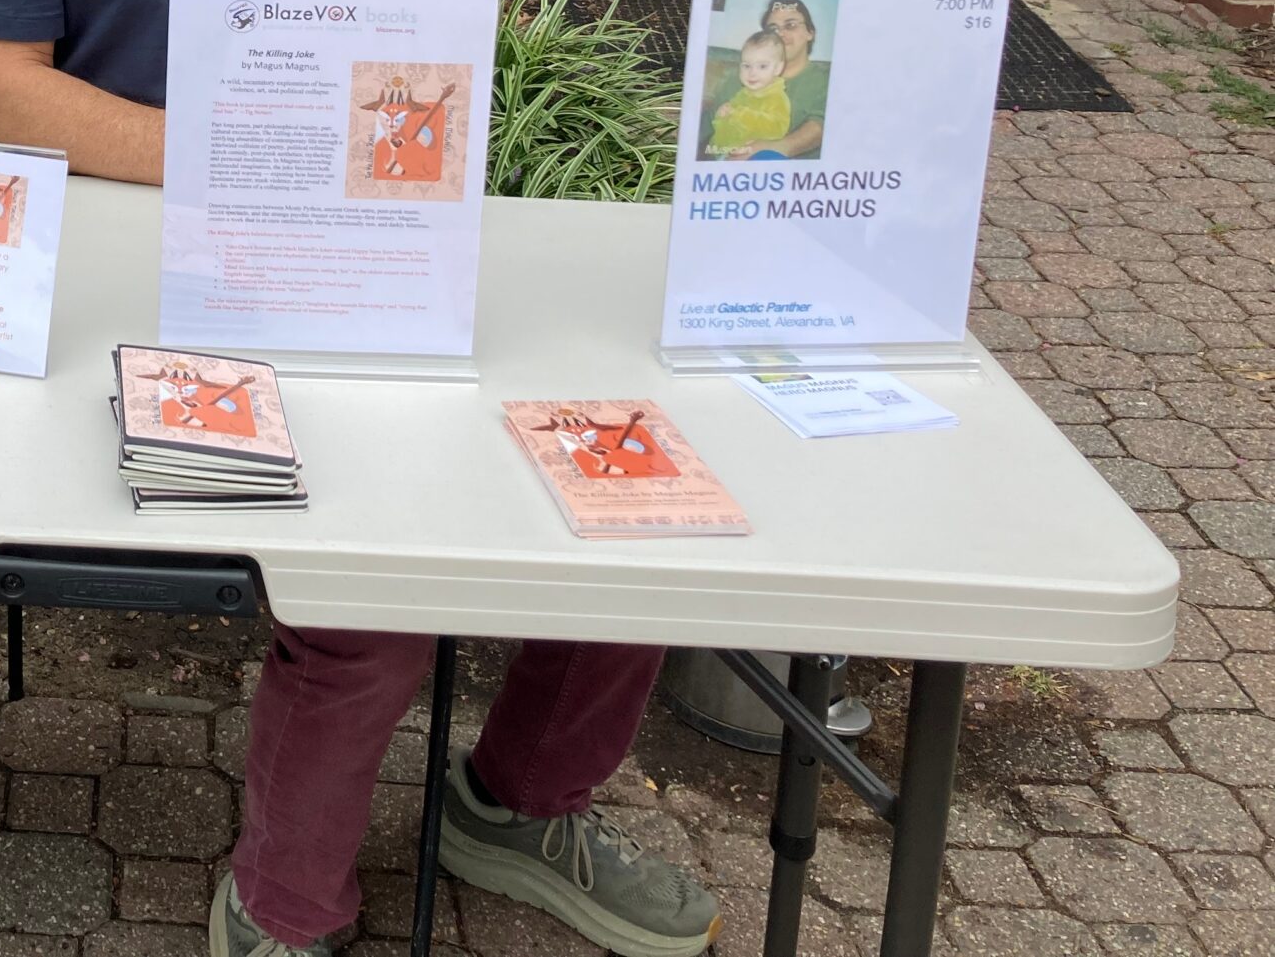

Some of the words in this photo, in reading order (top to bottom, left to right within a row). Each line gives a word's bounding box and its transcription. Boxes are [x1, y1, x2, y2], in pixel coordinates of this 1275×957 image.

[771, 1, 799, 13] Poet
[366, 6, 418, 23] books
[965, 16, 992, 29] $16
[248, 49, 265, 58] The
[266, 49, 296, 60] Killing
[298, 50, 315, 59] Joke
[241, 61, 252, 70] by
[254, 61, 283, 71] Magus
[285, 62, 320, 72] Magnus
[691, 172, 785, 192] MAGUS
[791, 170, 901, 191] MAGNUS
[689, 201, 760, 221] HERO
[766, 199, 877, 219] MAGNUS
[680, 303, 703, 314] Live
[704, 304, 716, 314] at
[717, 302, 764, 313] Galactic
[766, 302, 812, 313] Panther
[679, 318, 705, 329] 1300
[709, 318, 734, 330] King
[840, 315, 855, 326] VA
[76, 581, 168, 598] LIFETIME
